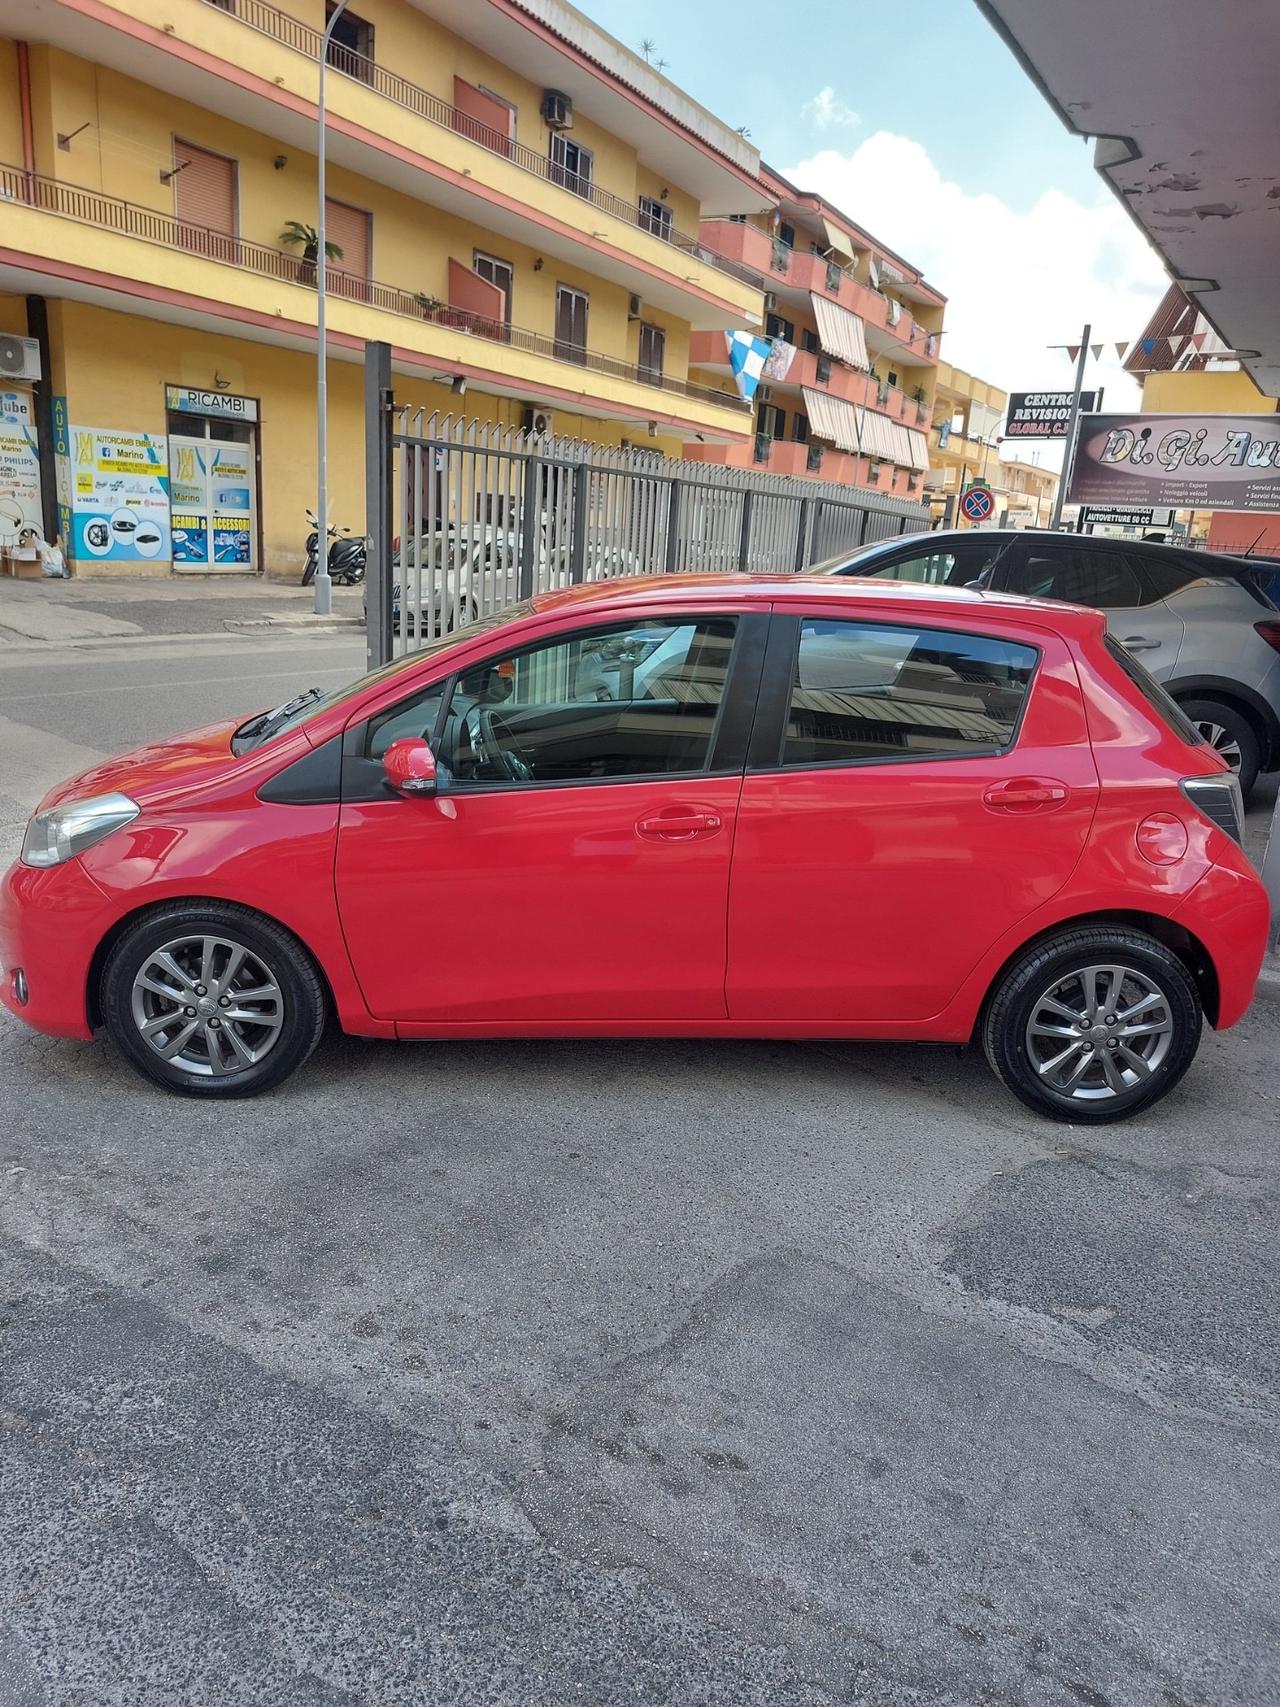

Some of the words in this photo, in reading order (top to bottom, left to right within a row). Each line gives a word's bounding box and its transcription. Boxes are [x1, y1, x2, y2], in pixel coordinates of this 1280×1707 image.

[188, 391, 245, 412] RICAMBI
[1024, 394, 1074, 406] CENTRO
[1014, 408, 1083, 420] REVISIO
[1008, 422, 1051, 434] GLOBAL
[117, 449, 144, 459] Marino
[4, 456, 33, 466] PHILIPS
[174, 492, 200, 503] Marino
[1163, 489, 1188, 497] Noleggio
[172, 515, 200, 529] ICAMBI
[1086, 513, 1131, 523] AUTOVETTURE
[1132, 515, 1140, 524] 50
[1141, 516, 1150, 524] CC
